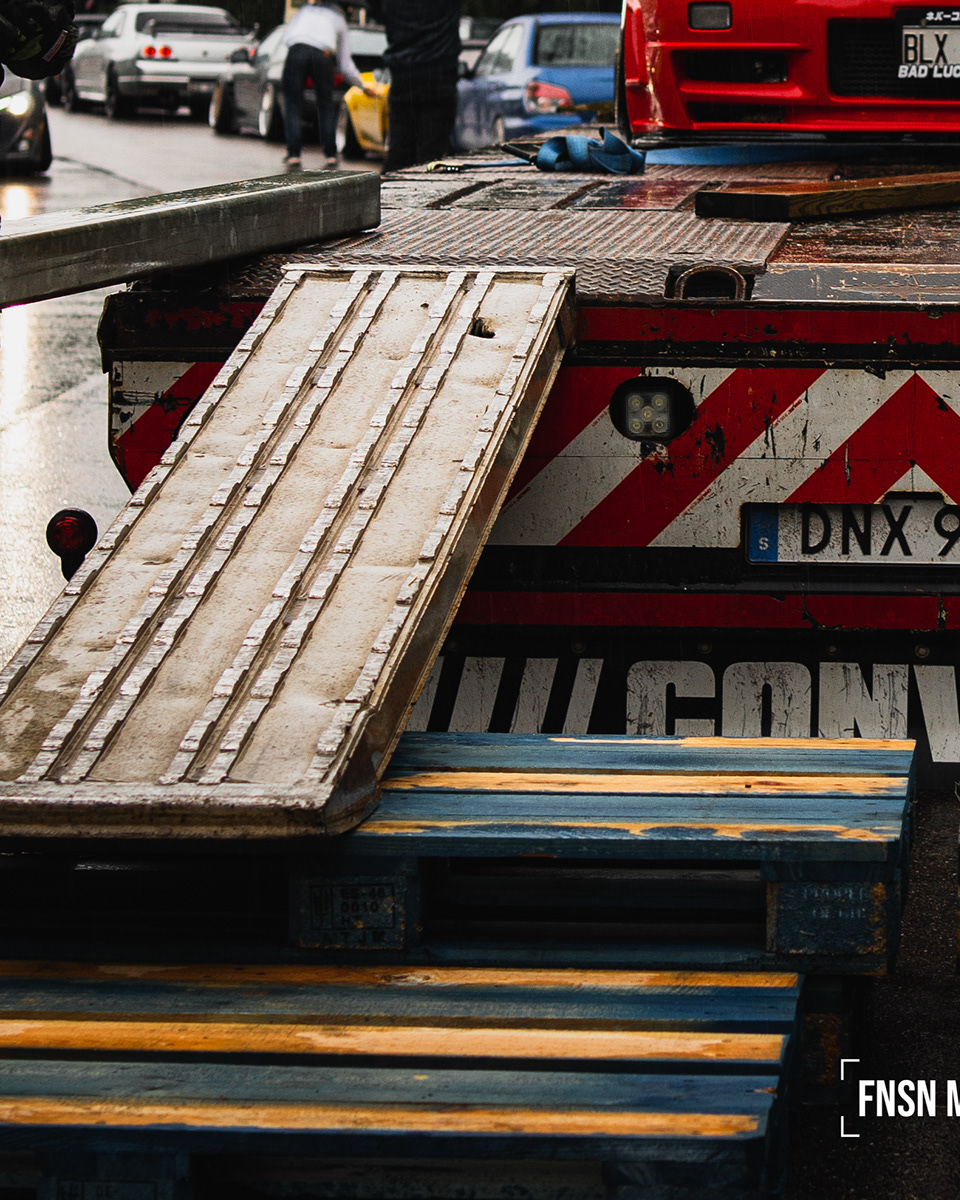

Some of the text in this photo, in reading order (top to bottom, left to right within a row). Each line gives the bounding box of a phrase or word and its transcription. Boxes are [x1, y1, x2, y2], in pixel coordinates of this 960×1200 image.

[904, 34, 948, 64] BLX
[898, 65, 928, 78] BAD
[801, 504, 912, 556] DNX
[758, 537, 769, 551] S
